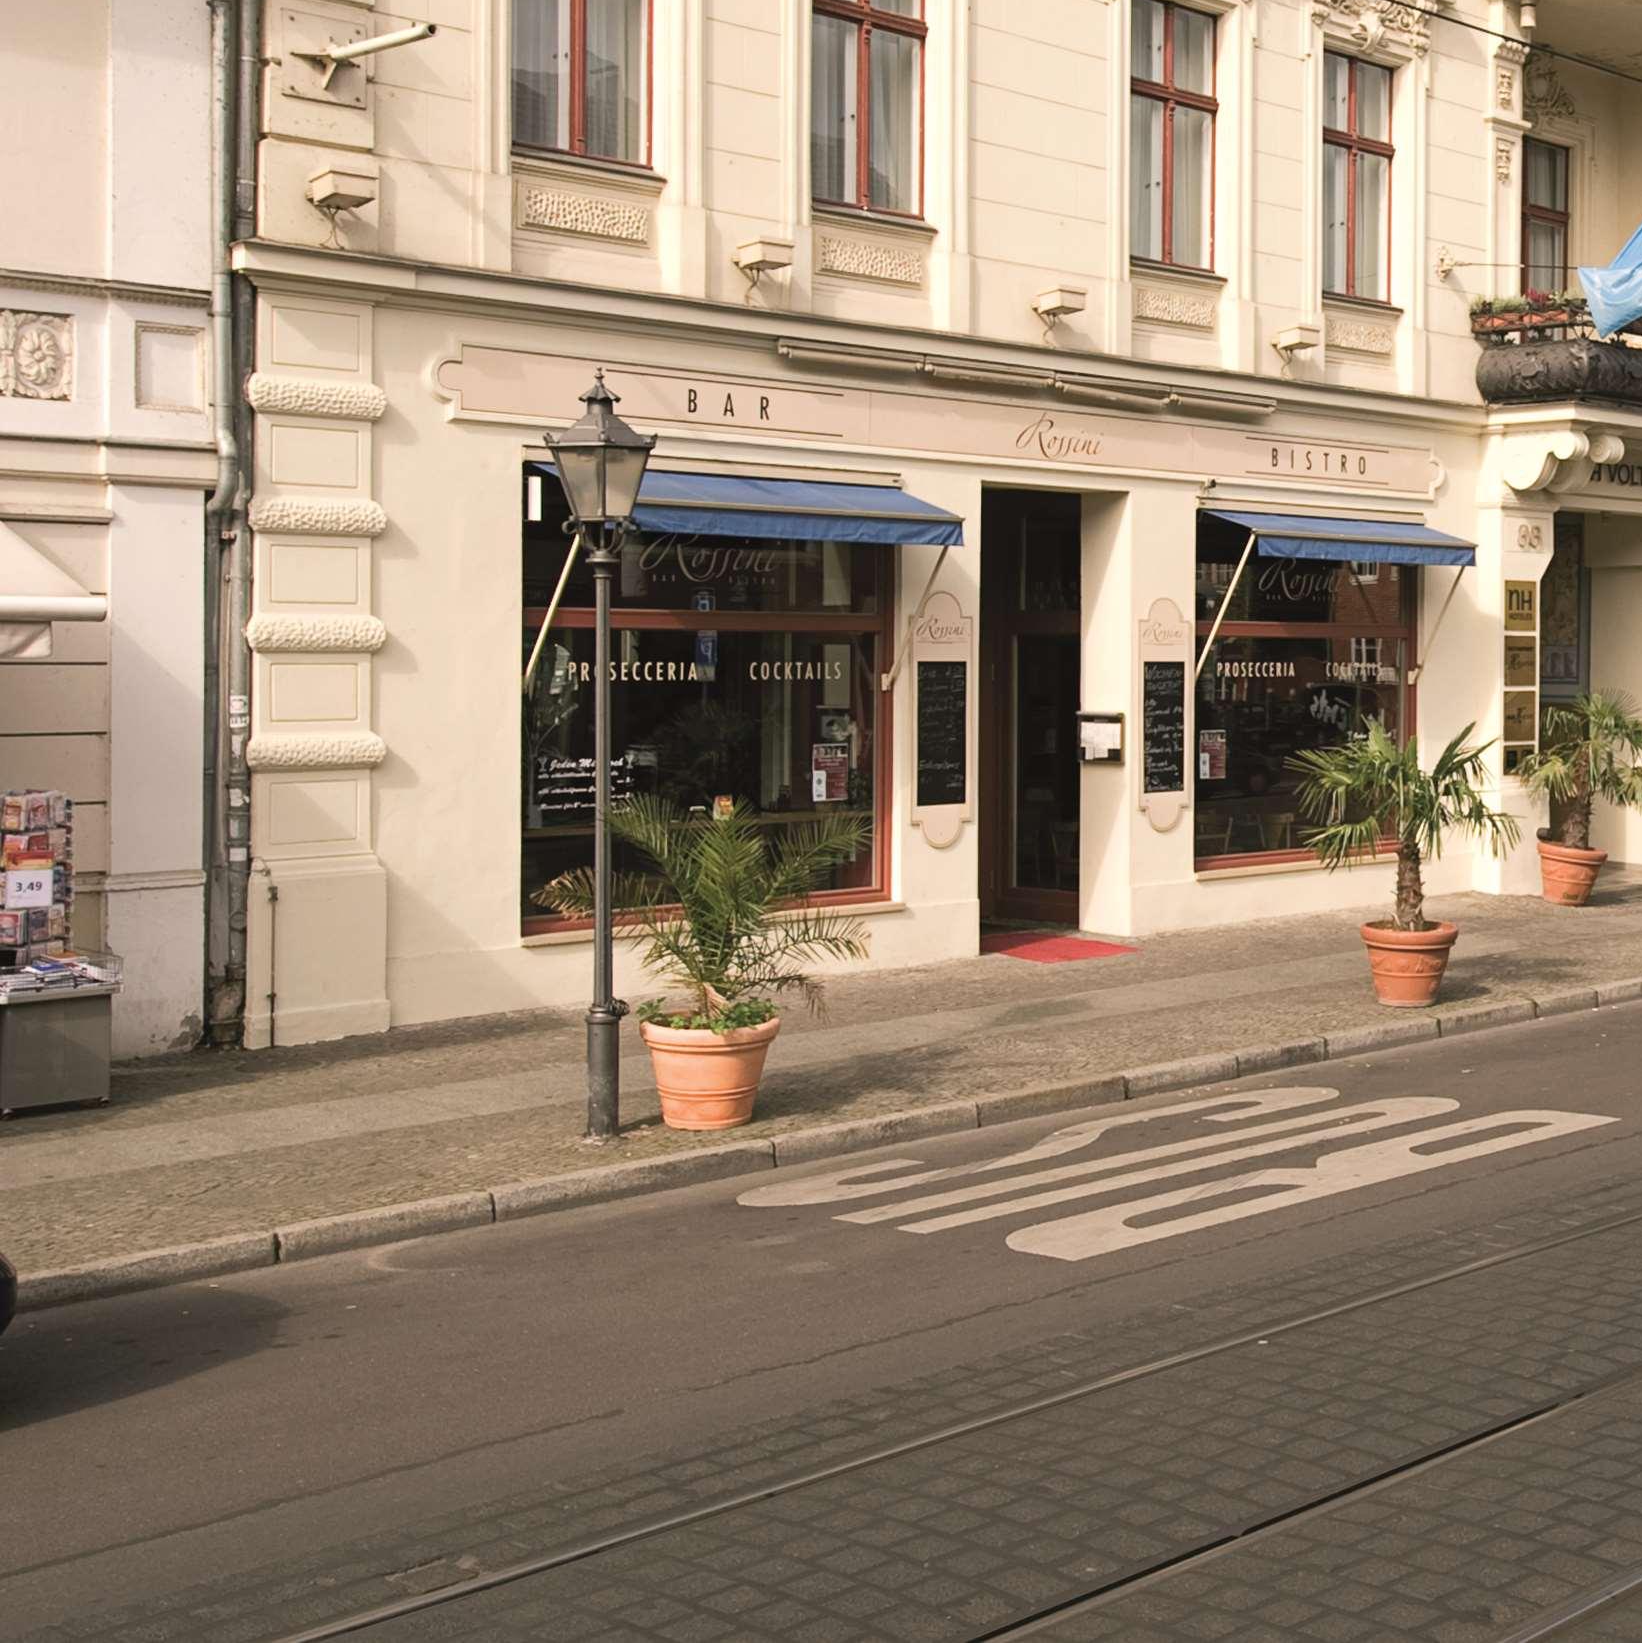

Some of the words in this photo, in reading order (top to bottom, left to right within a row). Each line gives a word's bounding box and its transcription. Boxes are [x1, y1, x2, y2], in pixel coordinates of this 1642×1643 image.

[687, 387, 770, 421] BAR
[1016, 411, 1105, 460] Rossini
[1271, 447, 1367, 475] BISTRO
[567, 661, 698, 682] PRSECCERIA
[750, 661, 842, 681] COCKTAILS
[1217, 662, 1296, 678] PROSECCERIA
[15, 881, 42, 894] 3,49
